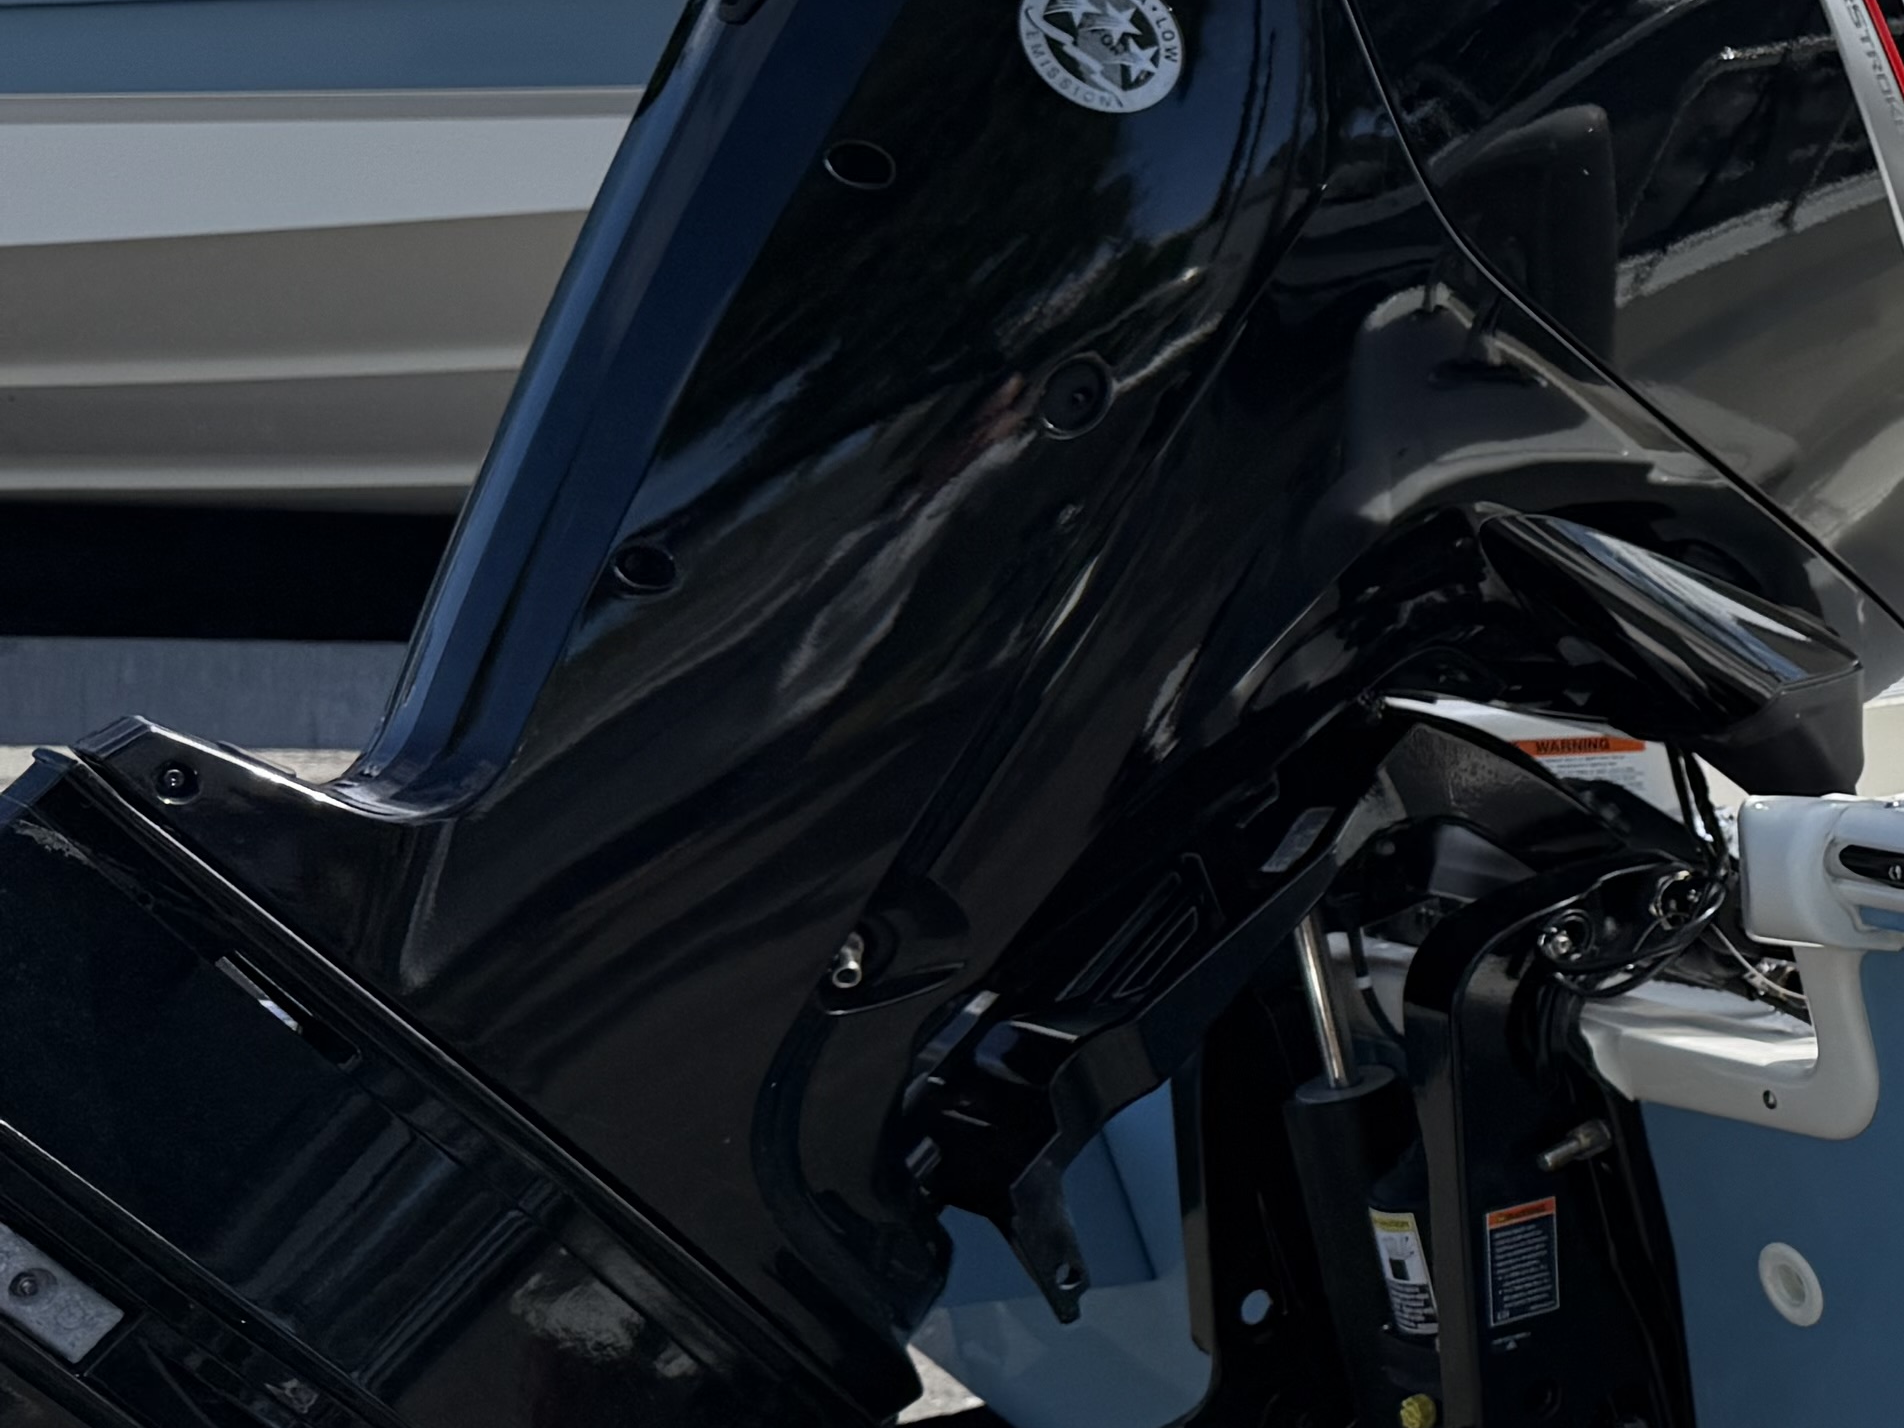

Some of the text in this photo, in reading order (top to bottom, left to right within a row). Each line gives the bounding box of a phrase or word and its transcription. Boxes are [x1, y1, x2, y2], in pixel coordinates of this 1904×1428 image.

[1156, 16, 1178, 64] LOW
[1026, 28, 1113, 107] EMISSION
[1536, 738, 1610, 754] WARNING
